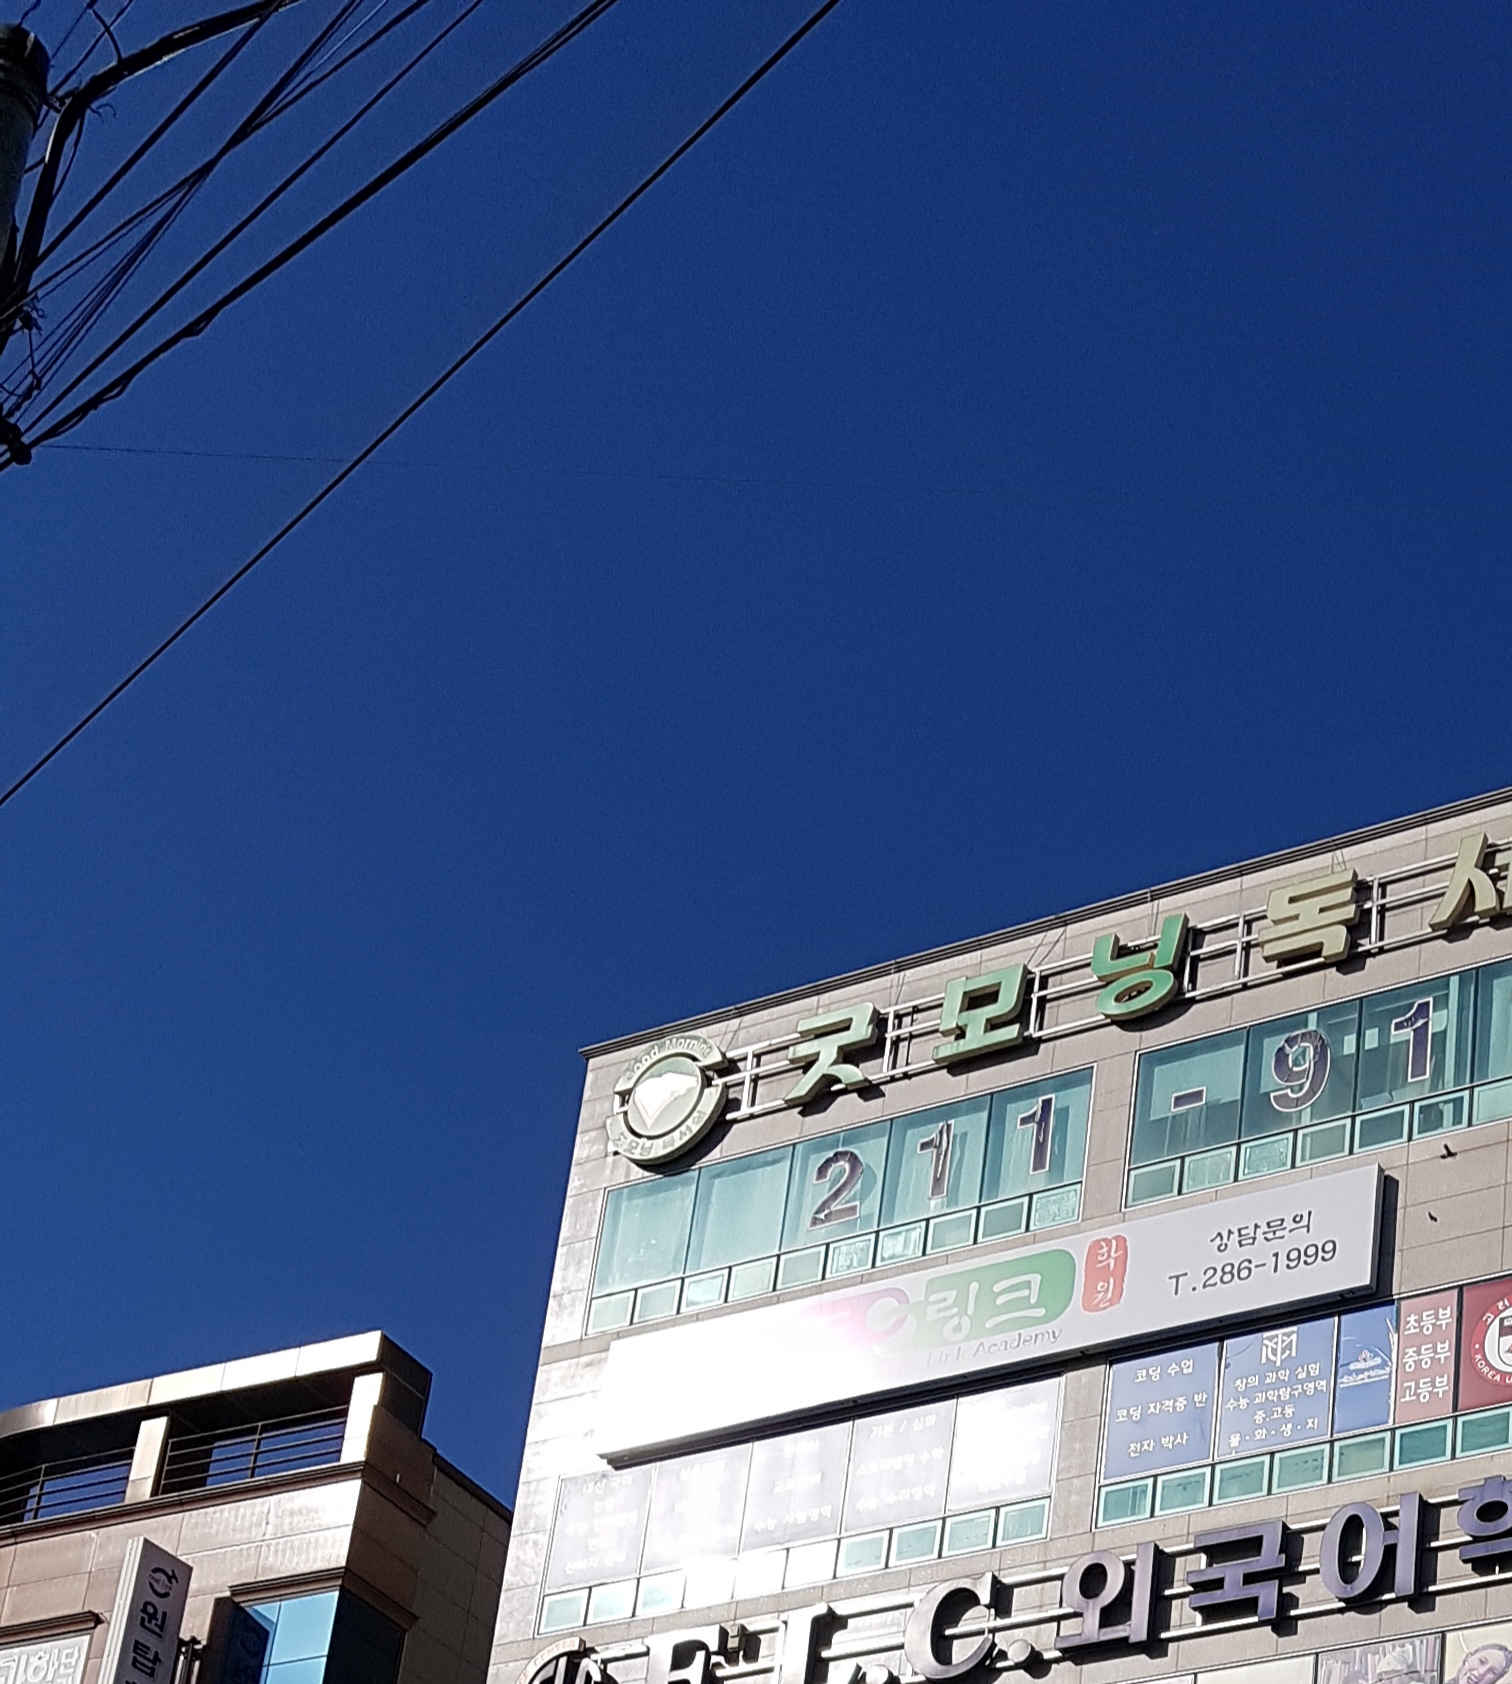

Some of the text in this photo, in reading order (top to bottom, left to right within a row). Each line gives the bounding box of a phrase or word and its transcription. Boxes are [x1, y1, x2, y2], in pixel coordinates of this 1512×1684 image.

[1209, 1209, 1313, 1252] 상담문의
[1088, 1237, 1123, 1309] 학원
[1168, 1238, 1338, 1297] T.286-1999
[1403, 1306, 1453, 1336] 초등부
[1134, 1358, 1194, 1384] 코딩 수업
[1402, 1340, 1451, 1373] 중등부
[1473, 1353, 1501, 1383] KOREA
[1264, 1368, 1290, 1386] 과학
[1294, 1362, 1321, 1380] 실험
[1400, 1373, 1450, 1404] 고등부
[1114, 1391, 1209, 1424] 코딩 자격증 반
[1225, 1393, 1251, 1411] 수능
[1160, 1433, 1189, 1450] 박사
